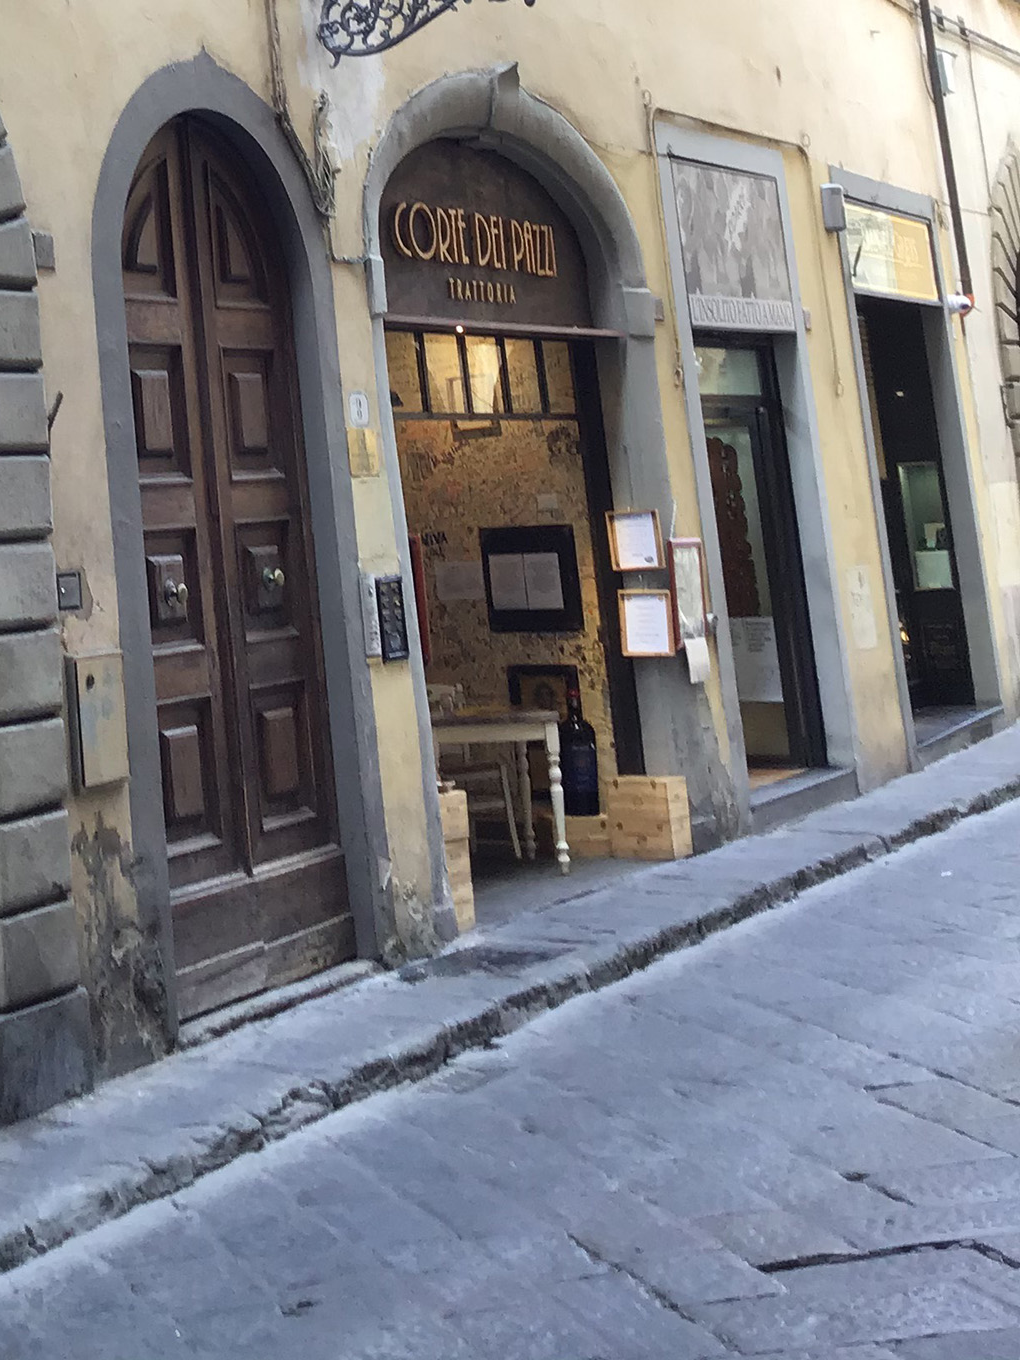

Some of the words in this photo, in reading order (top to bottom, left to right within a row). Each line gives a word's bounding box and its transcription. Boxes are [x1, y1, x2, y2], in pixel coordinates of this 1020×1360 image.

[393, 201, 470, 265] CORTE
[474, 212, 507, 271] DEI
[510, 218, 558, 278] PAZZI
[447, 277, 517, 305] TRATTORIA
